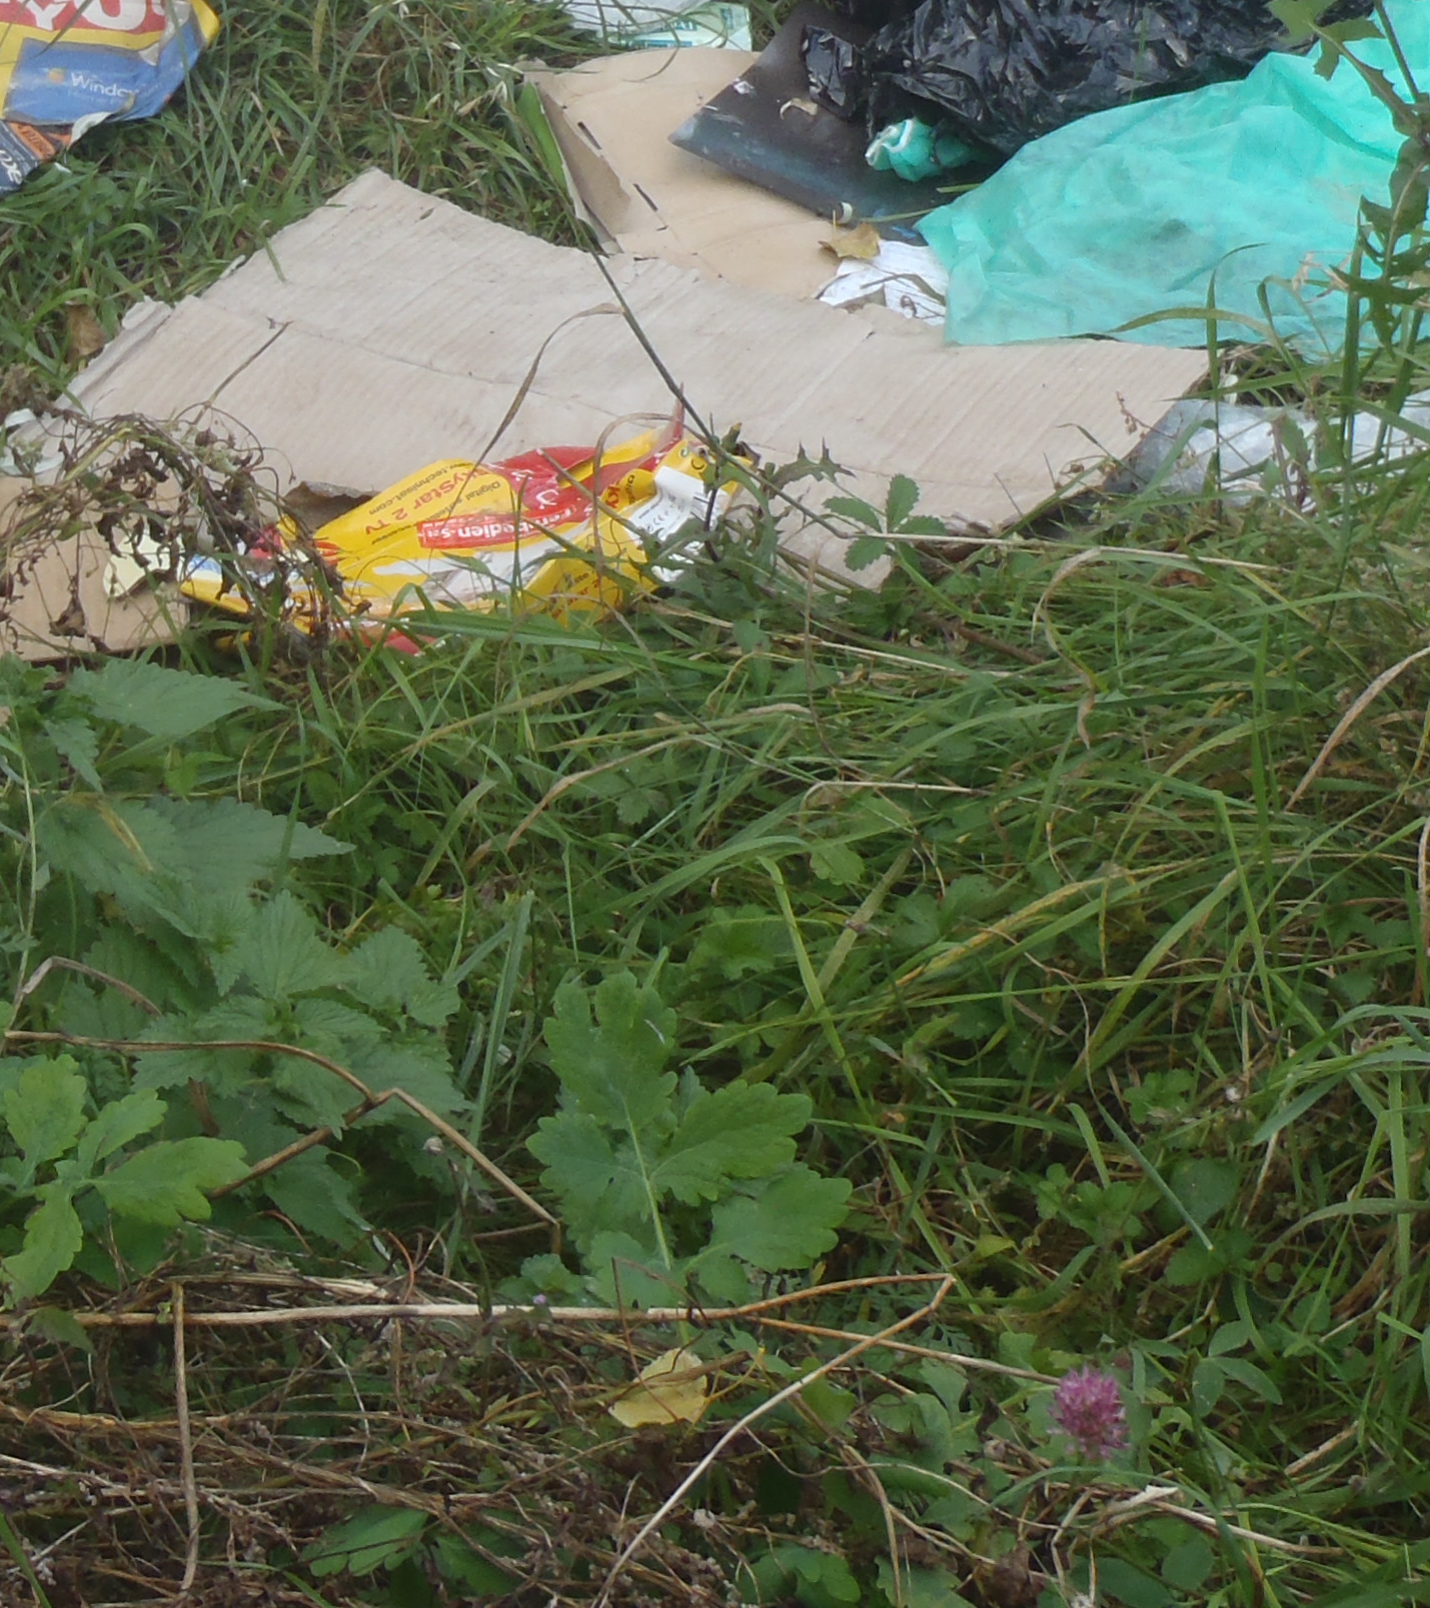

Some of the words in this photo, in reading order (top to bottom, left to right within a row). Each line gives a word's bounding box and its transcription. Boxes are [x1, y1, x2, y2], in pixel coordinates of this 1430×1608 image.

[465, 480, 501, 502] Digital
[391, 507, 408, 522] 2
[364, 518, 391, 536] TV
